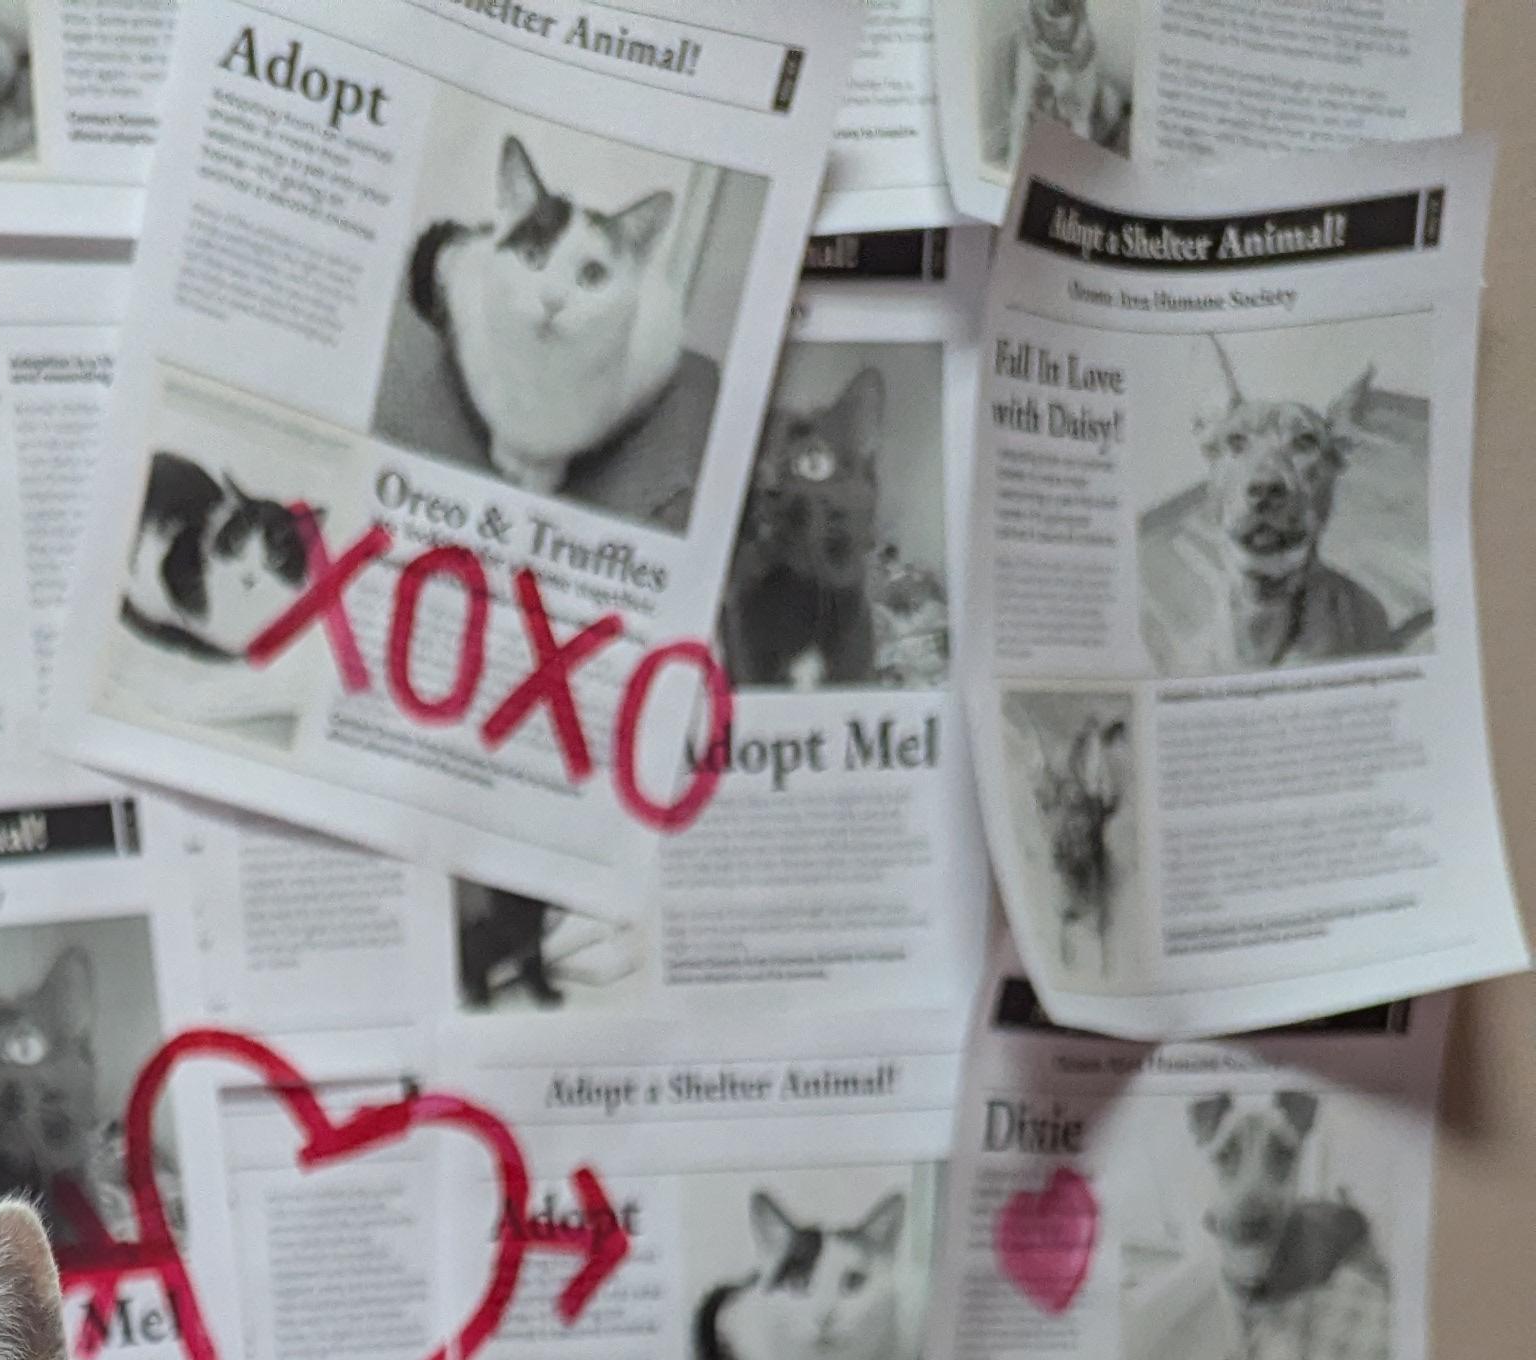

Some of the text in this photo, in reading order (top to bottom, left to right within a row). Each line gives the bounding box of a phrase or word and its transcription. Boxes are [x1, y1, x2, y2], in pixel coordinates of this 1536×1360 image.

[565, 16, 703, 76] Animal!
[216, 26, 391, 130] Adopt
[1049, 205, 1103, 261] Adopt
[1120, 221, 1214, 263] Shelter
[1217, 213, 1348, 261] Animal!
[994, 336, 1124, 396] Fall In Love
[991, 394, 1124, 455] with Daisy!
[374, 469, 468, 530] Oreo
[477, 505, 513, 546] &
[527, 514, 668, 594] Truffles
[246, 500, 736, 832] XOXO
[844, 714, 941, 771] Me!
[545, 1071, 638, 1116] Adopt
[669, 1070, 773, 1104] Shelter
[779, 1064, 896, 1101] Animal!
[981, 1099, 1085, 1156] Dixie
